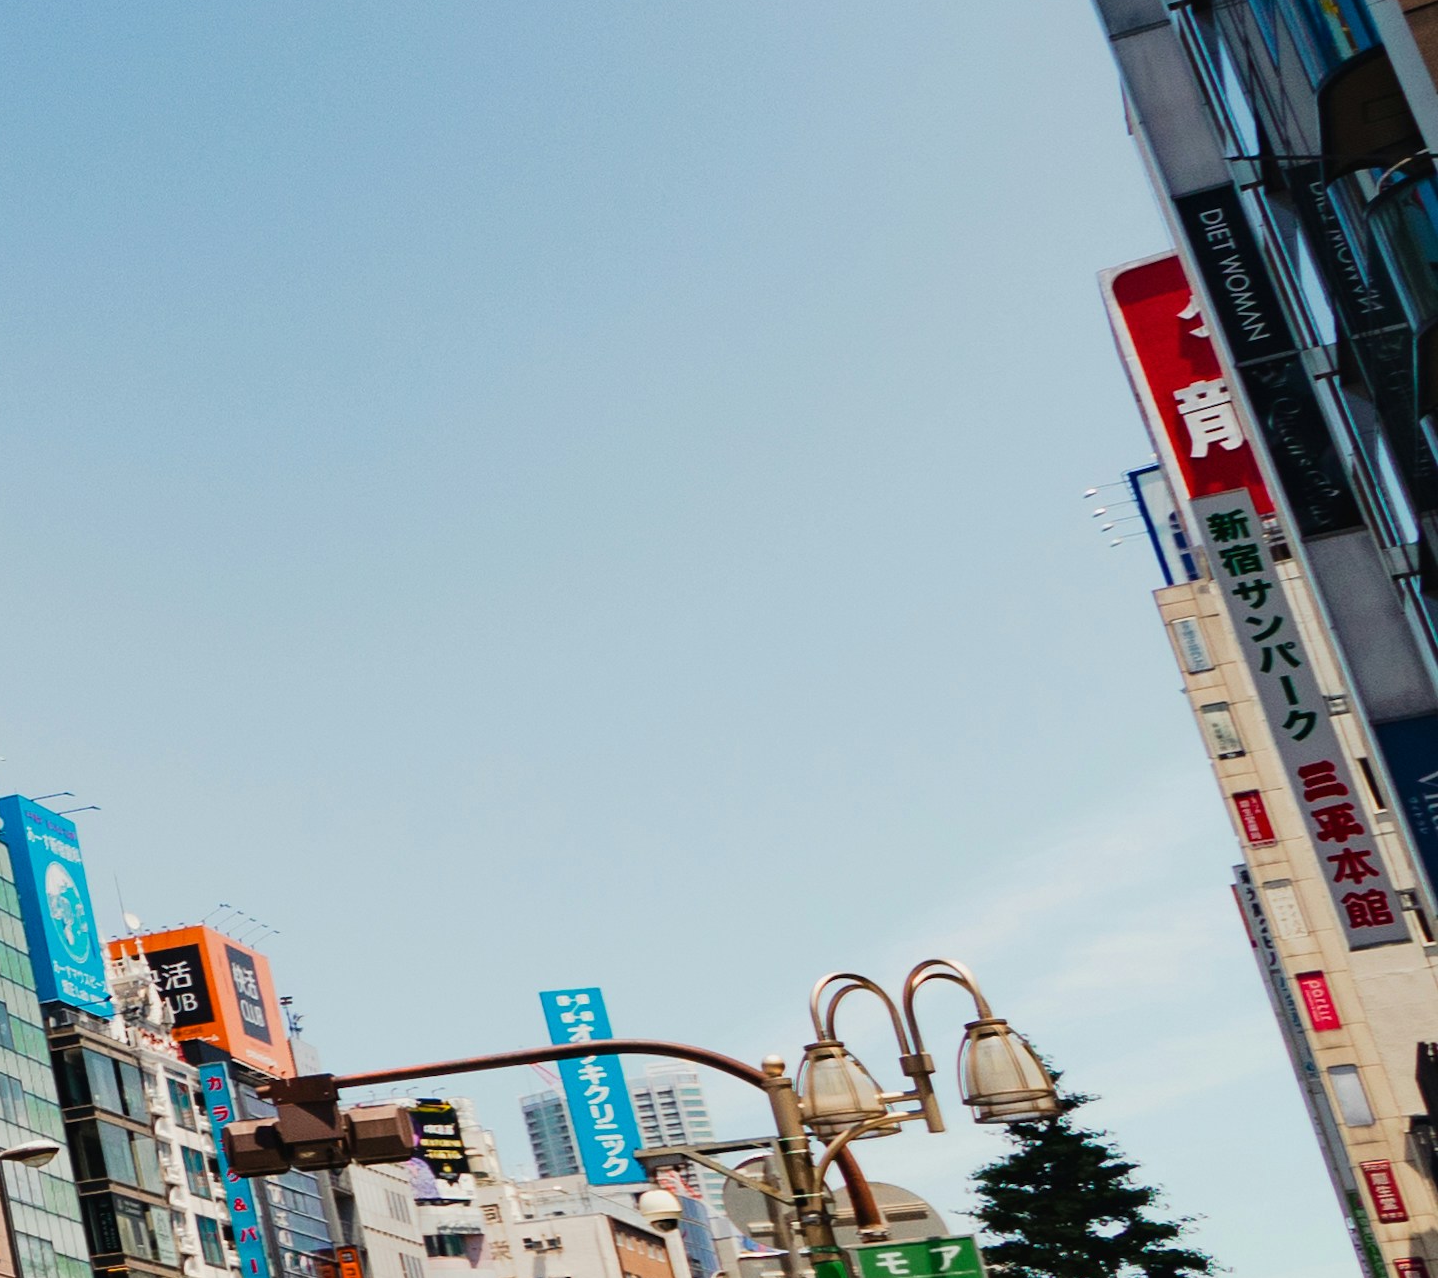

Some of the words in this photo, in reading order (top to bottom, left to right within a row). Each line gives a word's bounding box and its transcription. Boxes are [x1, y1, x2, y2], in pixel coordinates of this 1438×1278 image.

[1198, 207, 1228, 249] DIET
[1214, 251, 1272, 342] WOMAN
[1206, 509, 1319, 744] 新宿サンパーク
[1297, 760, 1395, 930] 三平本館
[876, 1246, 963, 1277] モア
